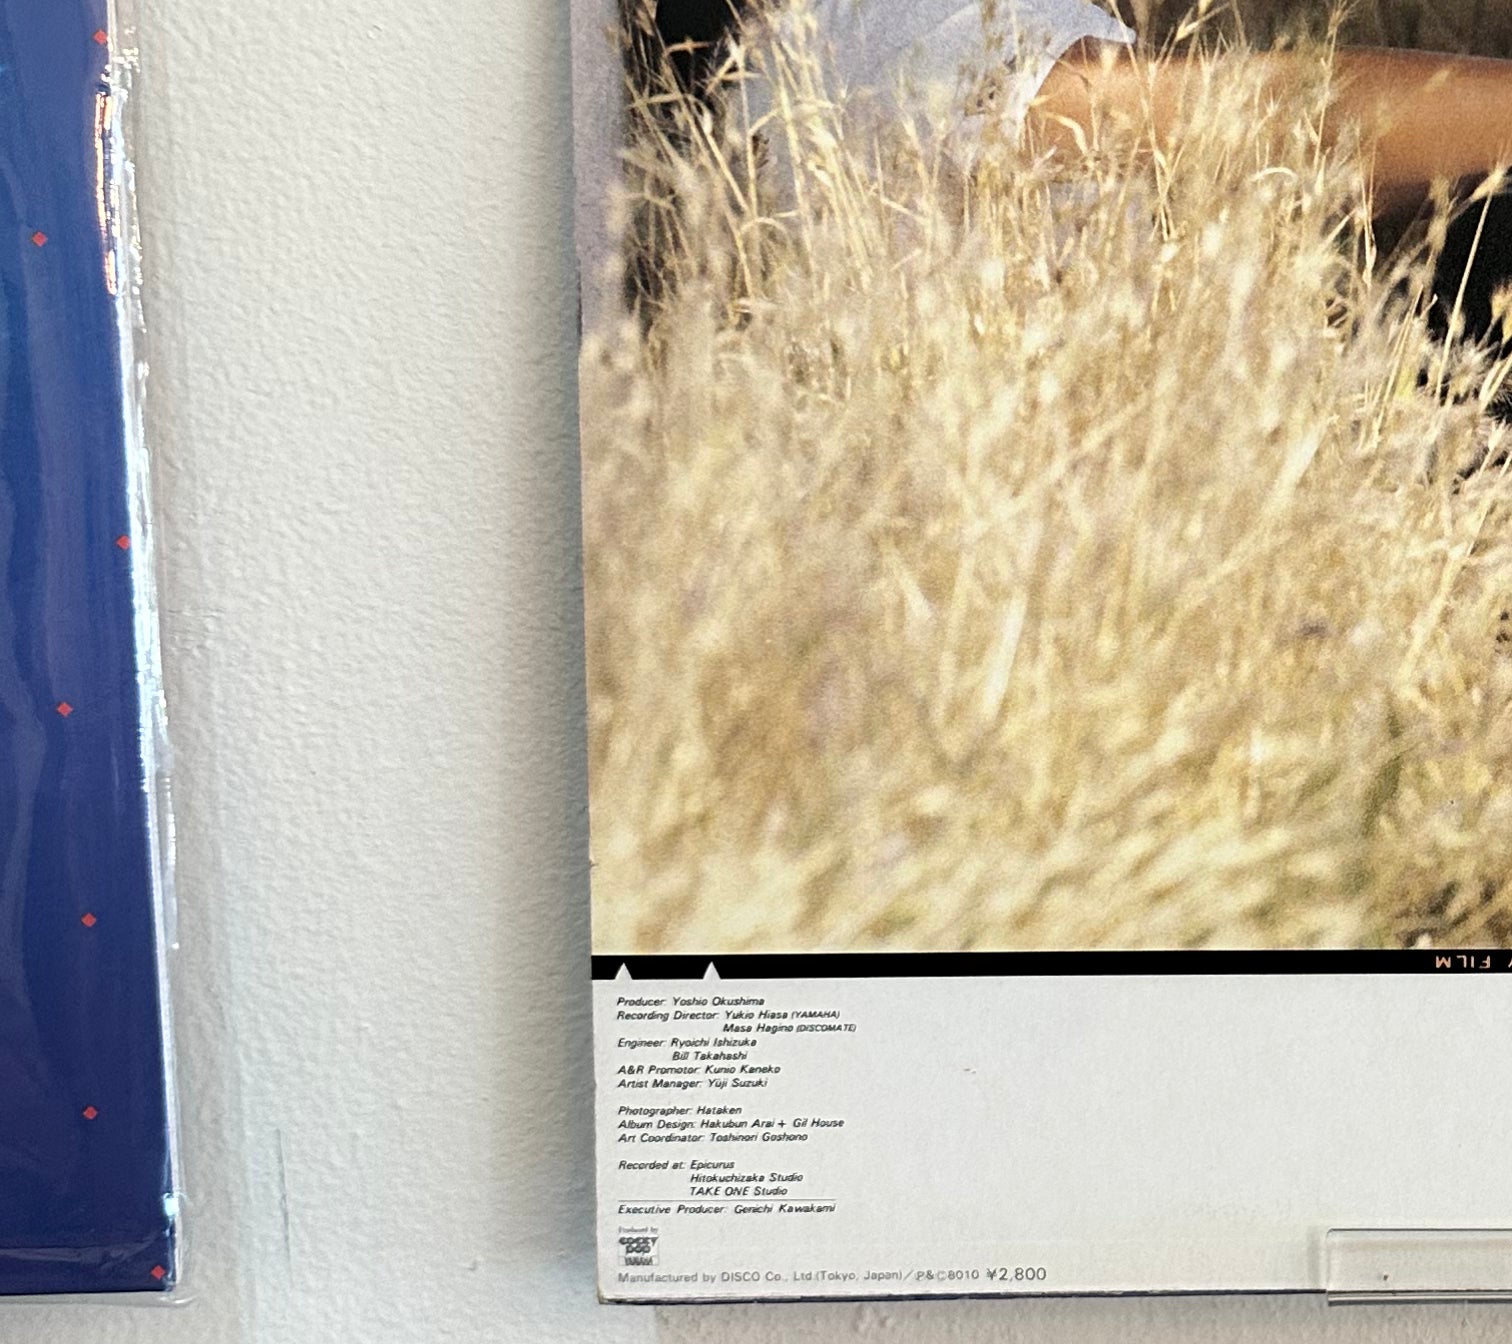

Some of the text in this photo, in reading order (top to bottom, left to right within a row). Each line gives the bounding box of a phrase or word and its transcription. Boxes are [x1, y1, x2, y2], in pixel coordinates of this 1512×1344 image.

[1435, 954, 1491, 969] FILM
[672, 997, 708, 1006] Yoshio
[712, 996, 765, 1006] Okushima
[616, 1010, 669, 1022] Recording
[791, 1010, 840, 1019] (YAMAHA)
[671, 1051, 748, 1061] Bill Takahashi
[617, 1065, 644, 1075] A&R
[704, 1065, 736, 1074] Kunio
[617, 1079, 649, 1089] Artist
[731, 1078, 768, 1088] Suzuki
[696, 1105, 743, 1115] Hataken
[617, 1119, 653, 1129] Album
[777, 1119, 787, 1128] +
[810, 1117, 845, 1128] House
[617, 1133, 637, 1143] Art
[618, 1160, 669, 1170] Recorded
[690, 1160, 735, 1171] Epicurus
[769, 1172, 804, 1183] Studio
[690, 1186, 788, 1196] TAKE ONE Studio
[618, 1204, 671, 1215] Executive
[778, 1203, 836, 1213] Kawakami
[618, 1272, 699, 1283] Manufactured
[703, 1272, 717, 1284] by
[721, 1271, 760, 1282] DISCO
